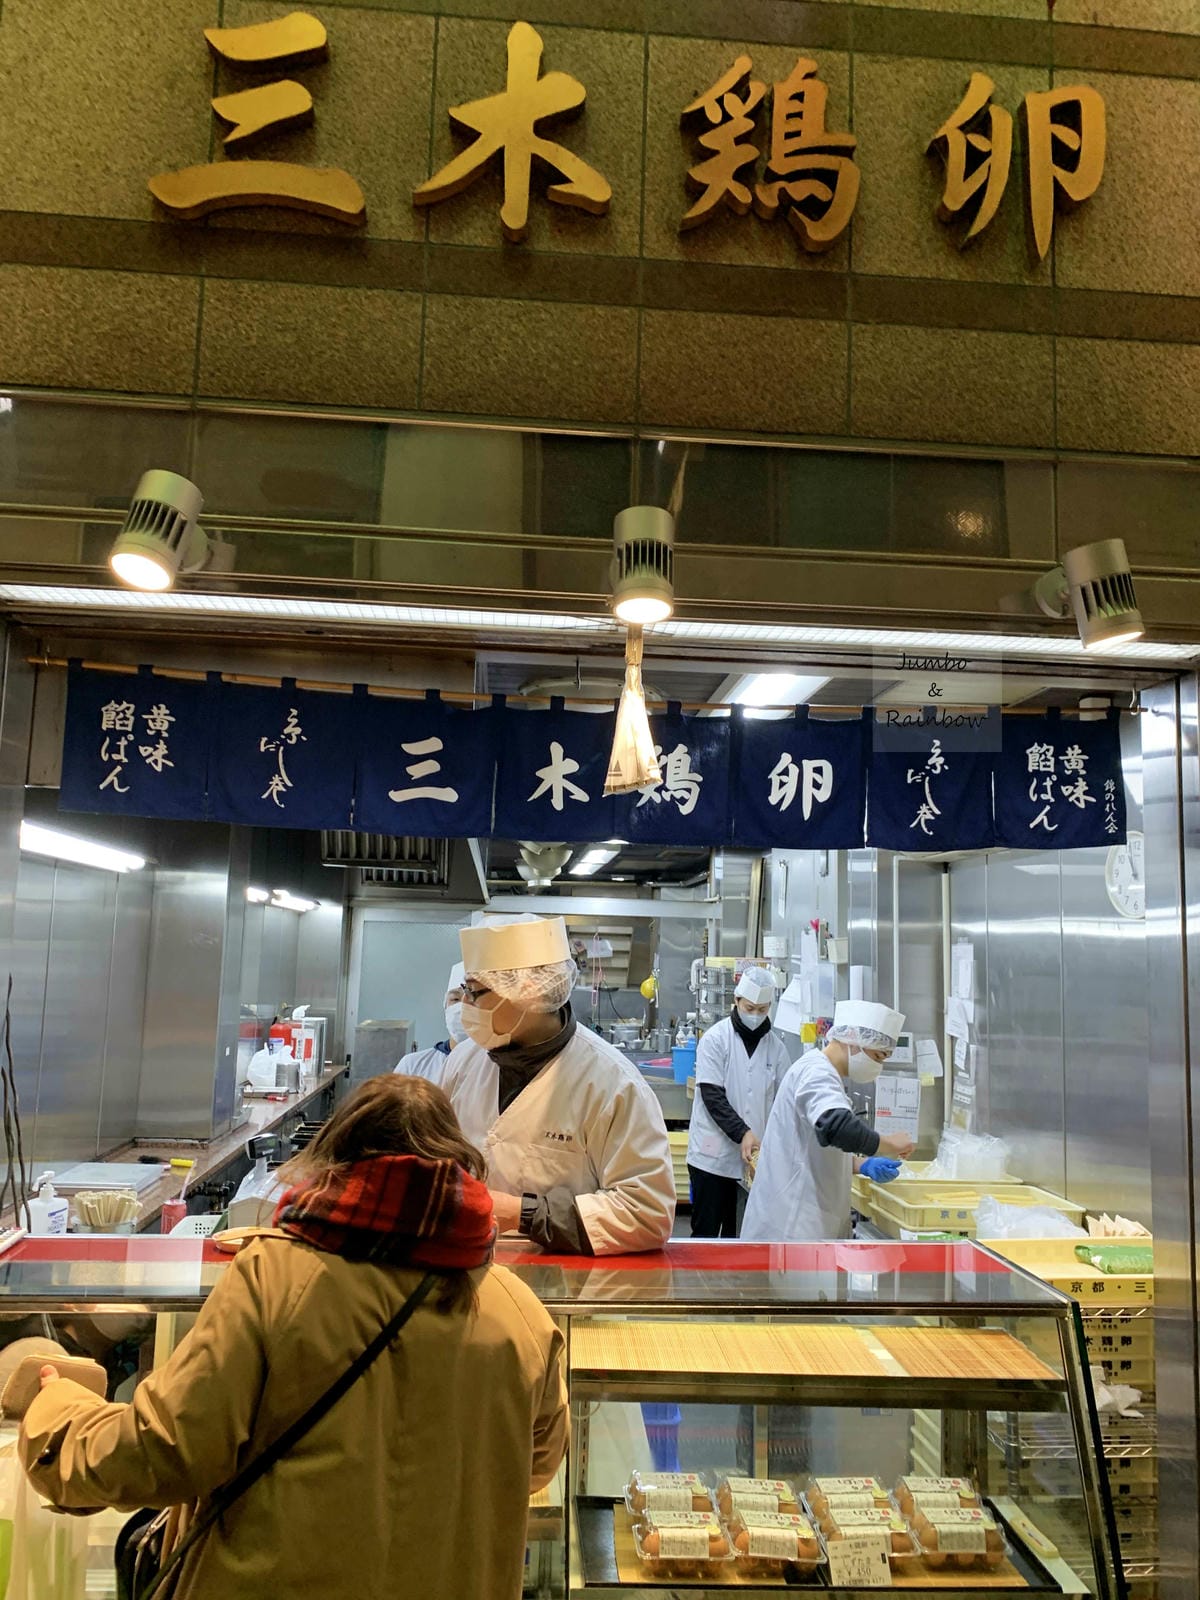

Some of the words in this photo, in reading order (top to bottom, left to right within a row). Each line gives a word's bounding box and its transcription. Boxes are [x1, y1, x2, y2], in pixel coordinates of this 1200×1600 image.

[148, 11, 1107, 260] 三木鶏卵
[99, 700, 136, 793] 餡ぱん
[139, 704, 176, 772] 黄味
[1059, 744, 1097, 809] 黄味
[1025, 742, 1059, 831] 餡ぱん
[1103, 779, 1119, 833] 錦のれん会
